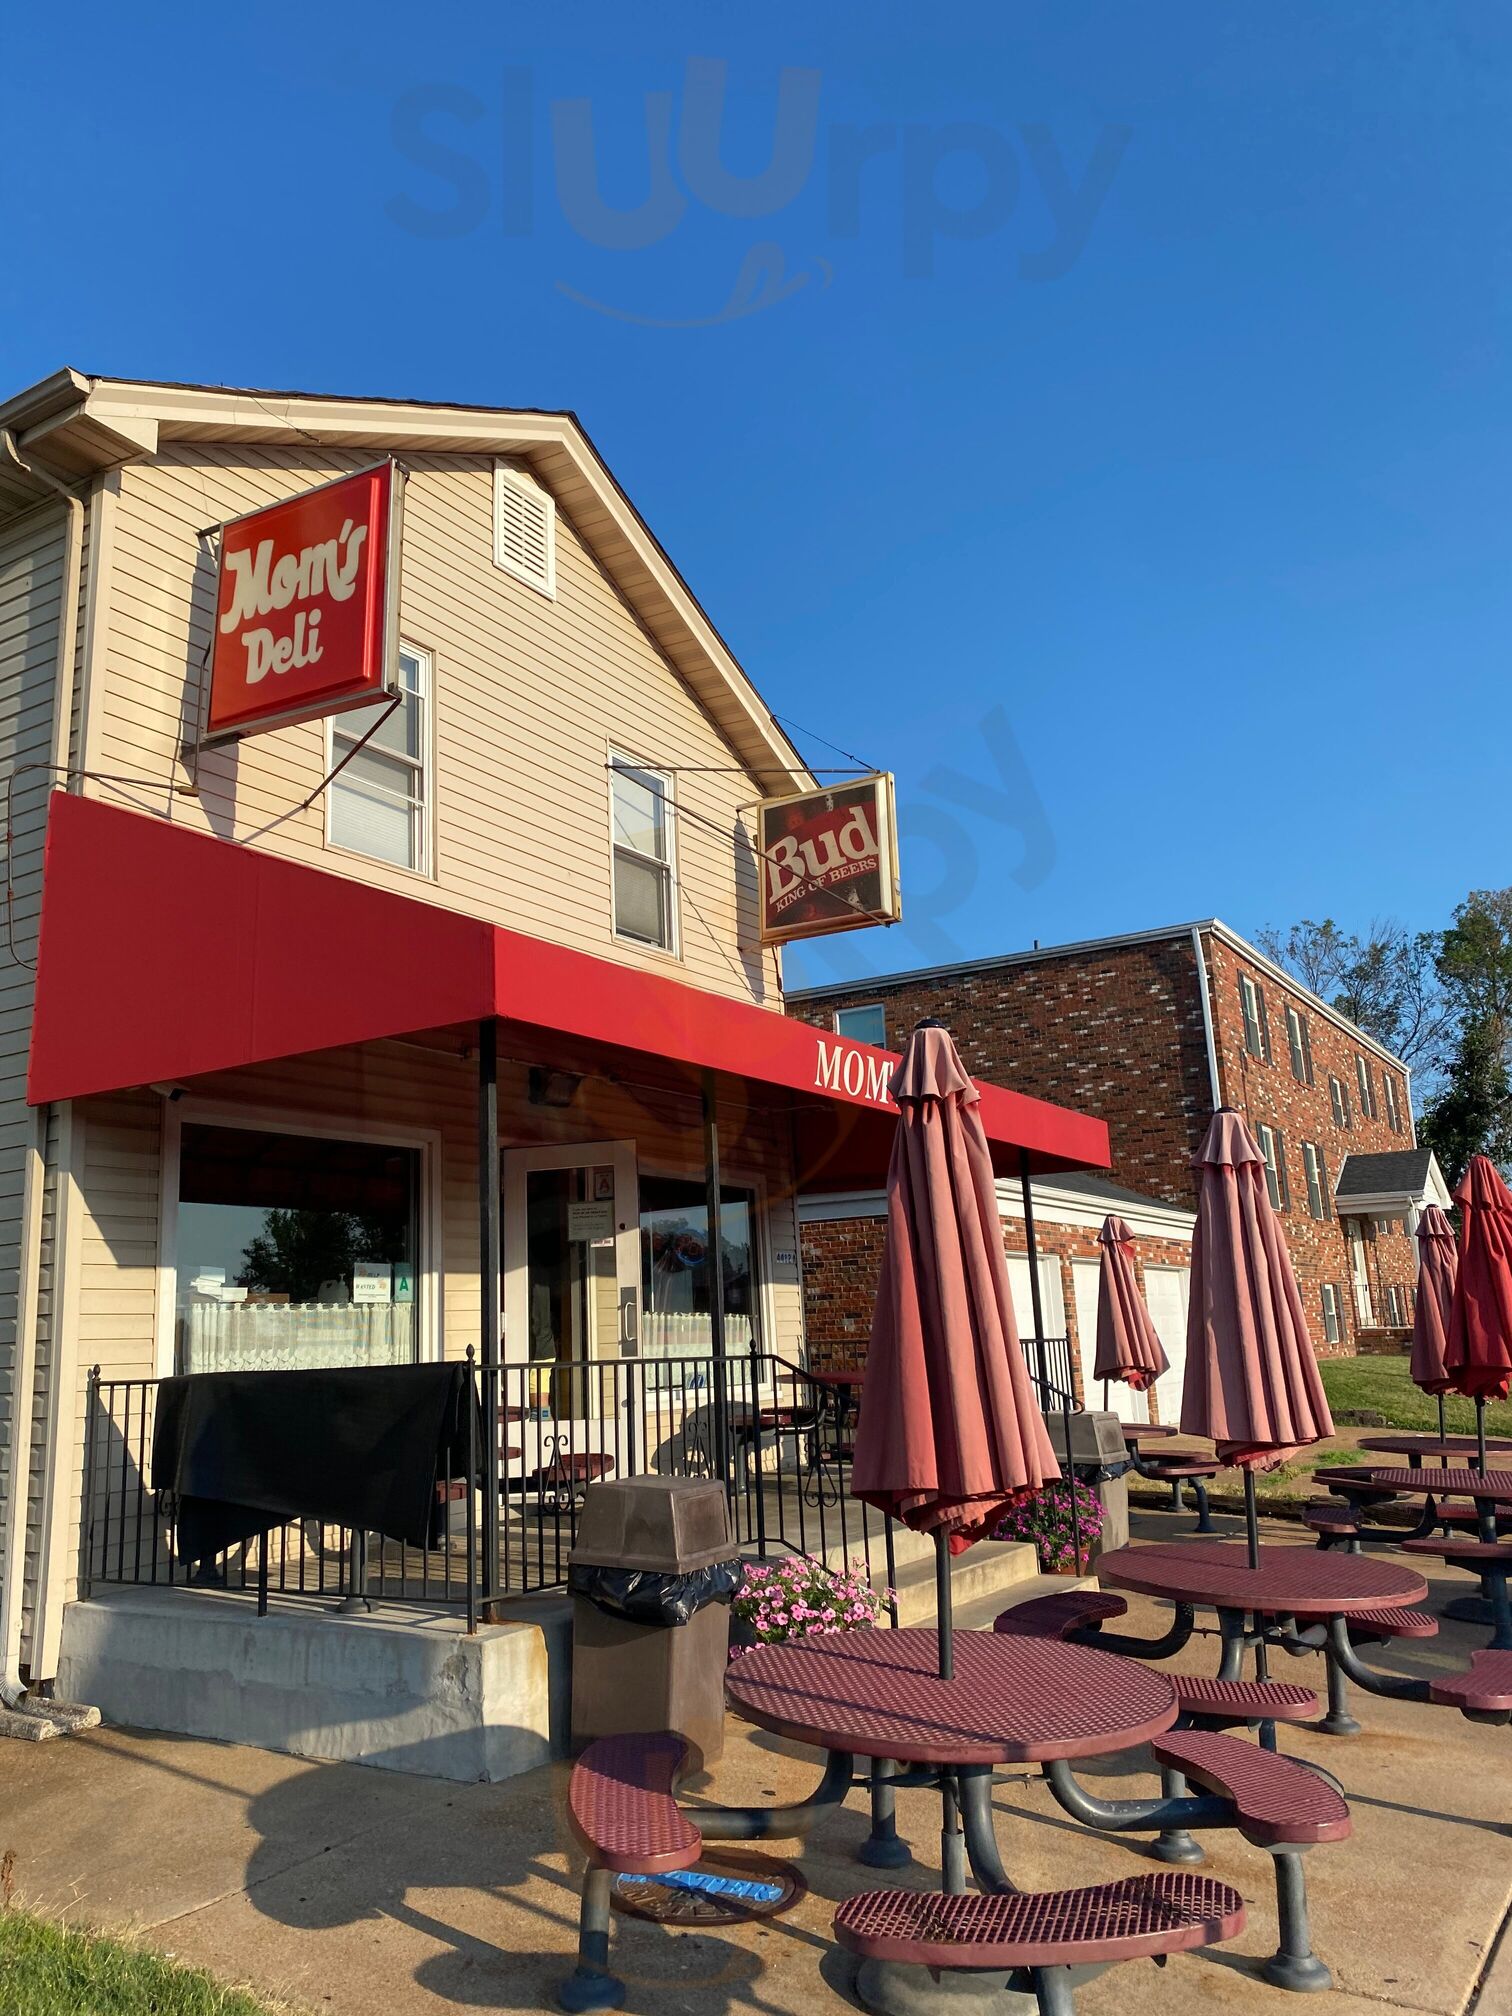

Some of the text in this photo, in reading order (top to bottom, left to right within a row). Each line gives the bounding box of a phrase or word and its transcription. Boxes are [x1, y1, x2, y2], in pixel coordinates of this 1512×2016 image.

[219, 518, 368, 634] Mom's
[241, 608, 323, 684] Deli
[765, 807, 879, 904] Bud
[777, 858, 877, 911] KING OF BEERS
[814, 1039, 899, 1107] MOM'
